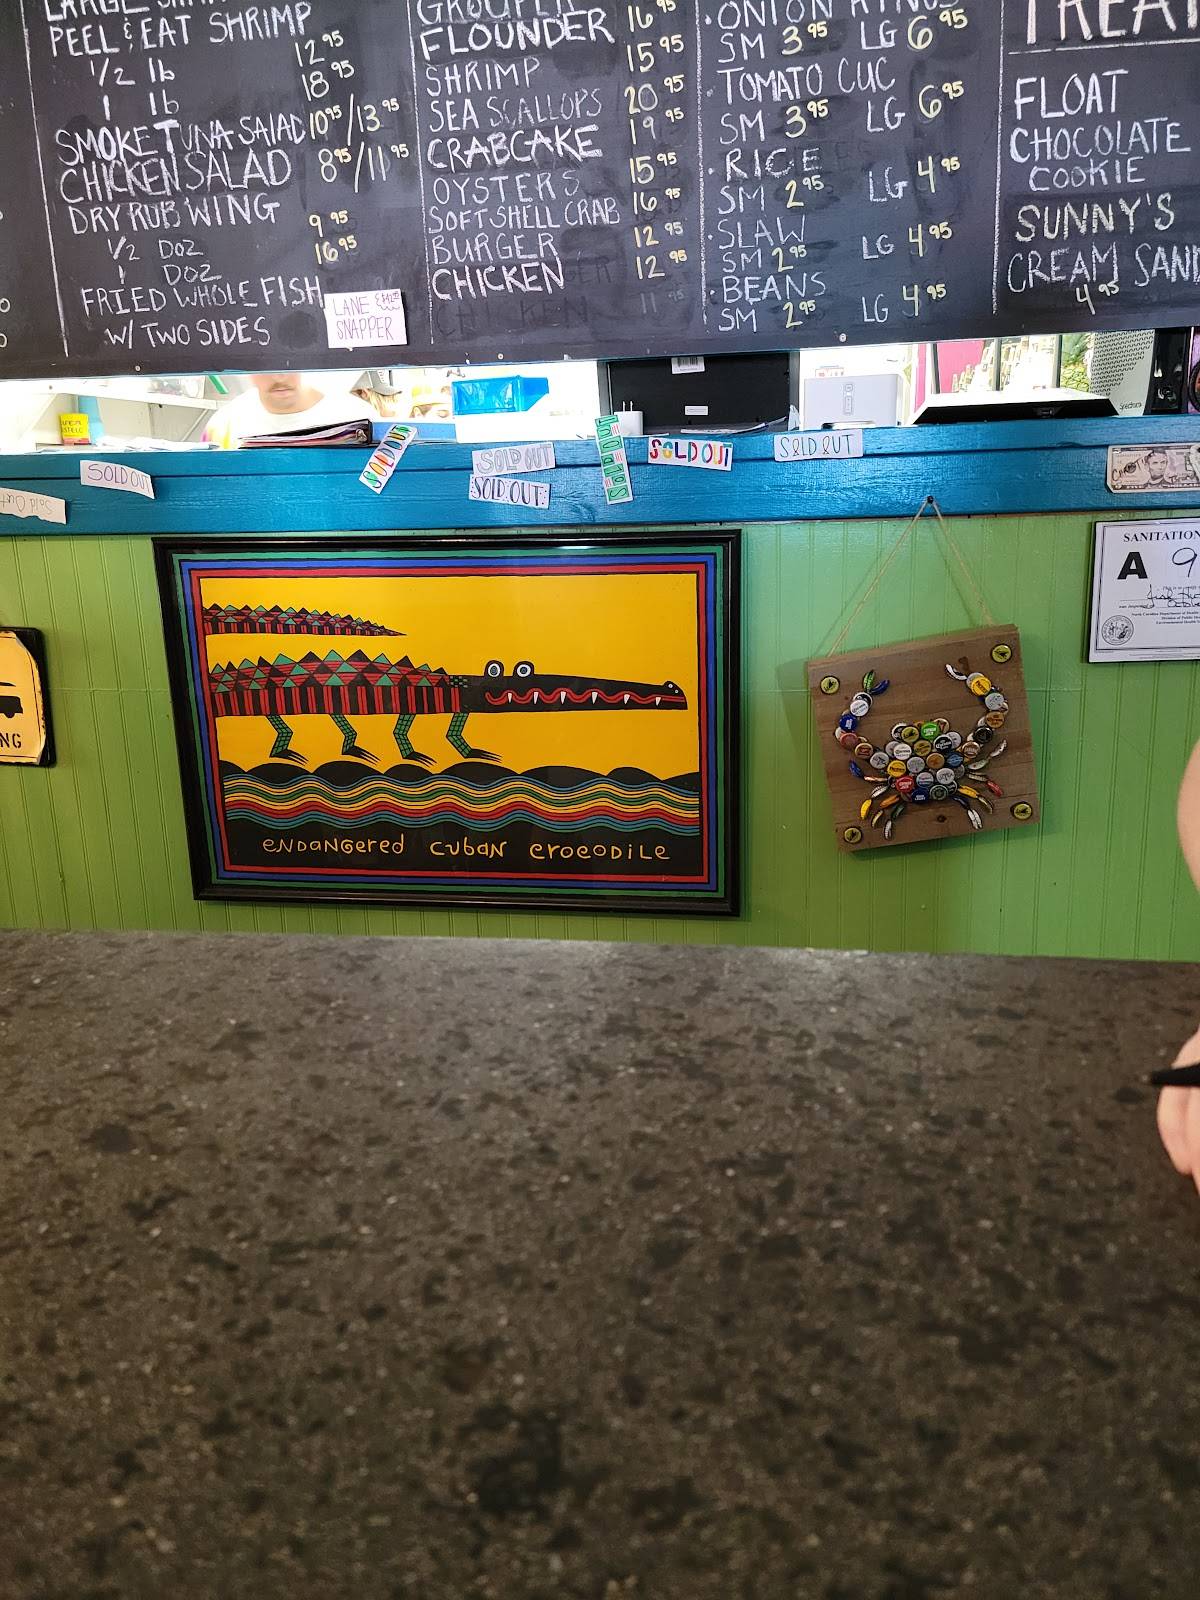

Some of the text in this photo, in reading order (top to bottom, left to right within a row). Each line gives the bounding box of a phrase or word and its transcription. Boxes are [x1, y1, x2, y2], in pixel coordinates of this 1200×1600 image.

[50, 25, 120, 57] PEEL
[140, 14, 191, 50] EAT
[209, 3, 312, 43] SHRIMP
[420, 8, 616, 60] FLOUNDER
[717, 0, 834, 29] ONION
[718, 33, 765, 63] SM
[861, 20, 898, 50] LG
[425, 55, 540, 97] SHRIMP
[717, 55, 896, 104] TOMATO CUC
[1014, 68, 1129, 120] FLOAT
[429, 88, 603, 132] SEA SCALLOPS
[719, 110, 765, 144] SM
[866, 96, 906, 132] LG
[55, 125, 158, 166] SMOKE
[427, 124, 603, 173] CRABCAKE
[1009, 117, 1192, 164] CHOCOLATE
[59, 157, 181, 204] CHICKEN
[184, 148, 292, 192] SALAD
[726, 147, 822, 182] RICE
[1028, 156, 1146, 192] COOKIE
[433, 169, 580, 205] OYSTERS
[718, 184, 765, 214] SM
[868, 166, 908, 202] LG
[69, 192, 281, 235] DRY RUB WING
[428, 196, 621, 234] SOFT SHELL CRAB
[717, 214, 806, 250] SLAW
[1015, 192, 1174, 243] SUNNY'S
[432, 232, 560, 265] BURGER
[722, 248, 763, 273] SM
[862, 234, 895, 260] LG
[1007, 241, 1119, 293] CREAM
[81, 276, 325, 318] FRIED WHOLE FISH
[432, 256, 565, 301] CHICKEN
[722, 271, 827, 304] BEANS
[333, 296, 370, 317] LANE
[718, 307, 758, 333] SM
[861, 293, 889, 323] LG
[141, 320, 191, 347] TWO
[199, 316, 271, 347] SIDES
[336, 316, 394, 341] SNAPPER
[476, 443, 552, 475] SOLD OUT
[649, 439, 733, 467] SOLD OUT
[780, 434, 855, 458] SOLD OUT
[88, 463, 151, 495] SOLD OUT
[363, 446, 396, 489] SOLD
[471, 477, 544, 507] SOLD OUT
[1123, 529, 1200, 543] SANITATION
[1117, 551, 1148, 580] A
